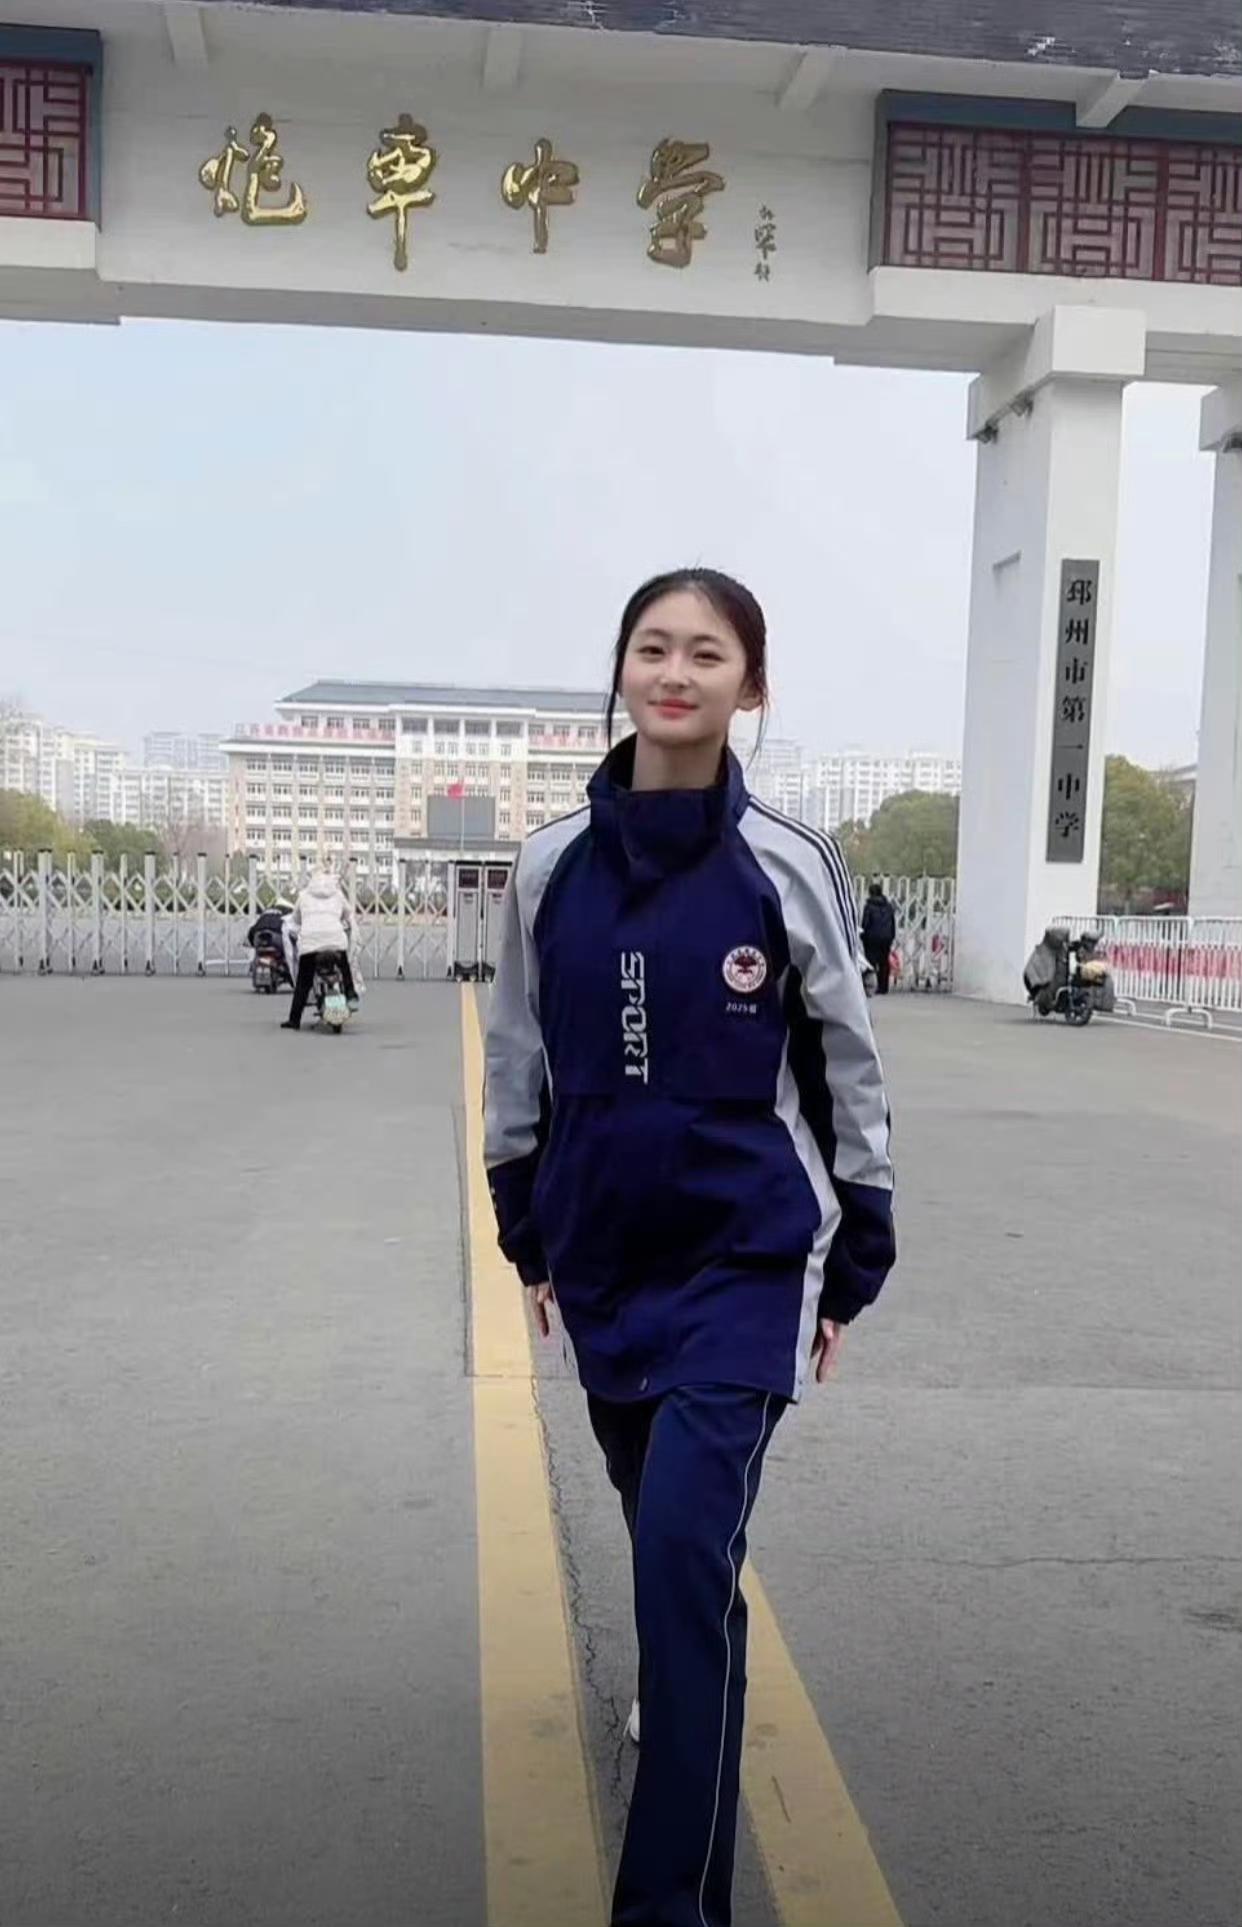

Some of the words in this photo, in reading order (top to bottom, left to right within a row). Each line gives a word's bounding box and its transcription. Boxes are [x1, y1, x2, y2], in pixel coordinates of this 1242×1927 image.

[1055, 579, 1092, 837] 邳州市第一中学
[621, 951, 648, 1084] SPORT
